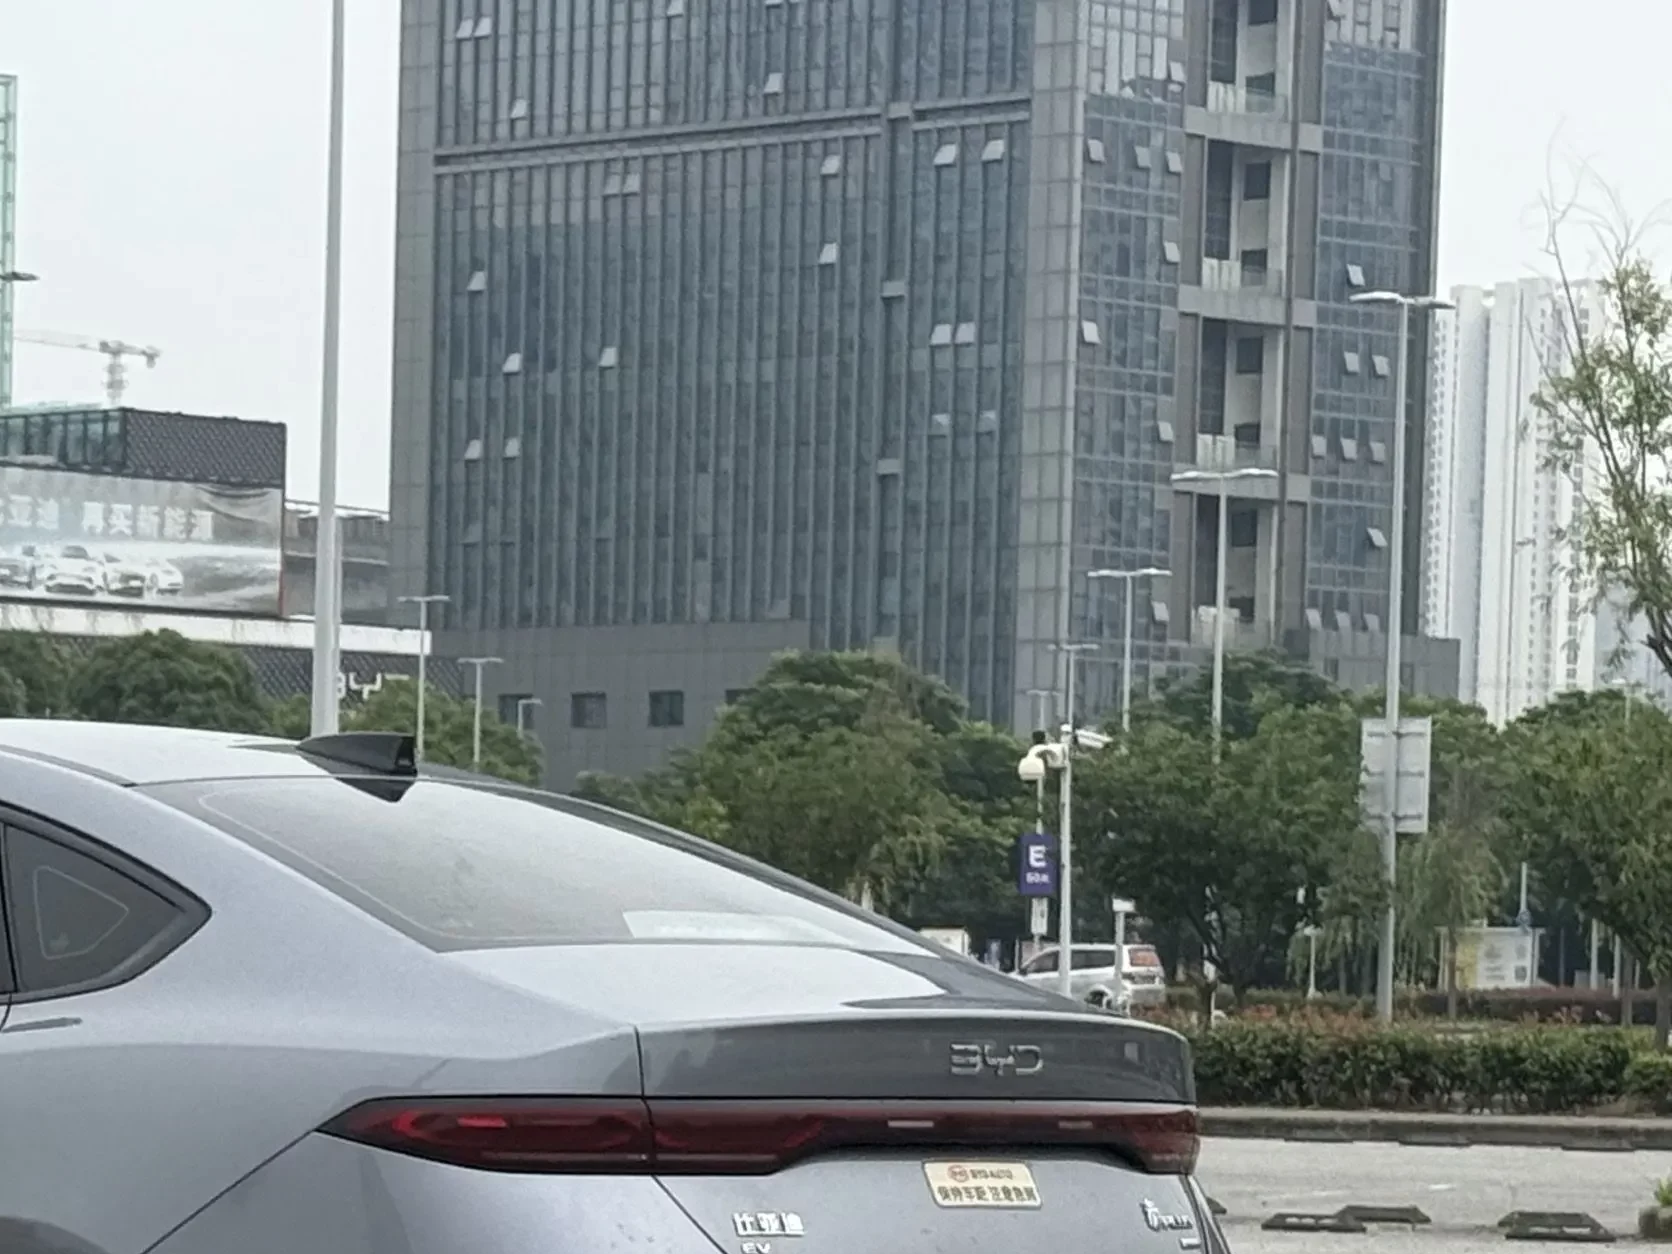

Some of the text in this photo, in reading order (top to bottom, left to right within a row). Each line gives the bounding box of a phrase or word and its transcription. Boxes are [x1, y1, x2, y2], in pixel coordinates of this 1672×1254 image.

[1029, 845, 1046, 868] E
[951, 1044, 1044, 1076] BYD
[741, 1242, 771, 1254] EV
